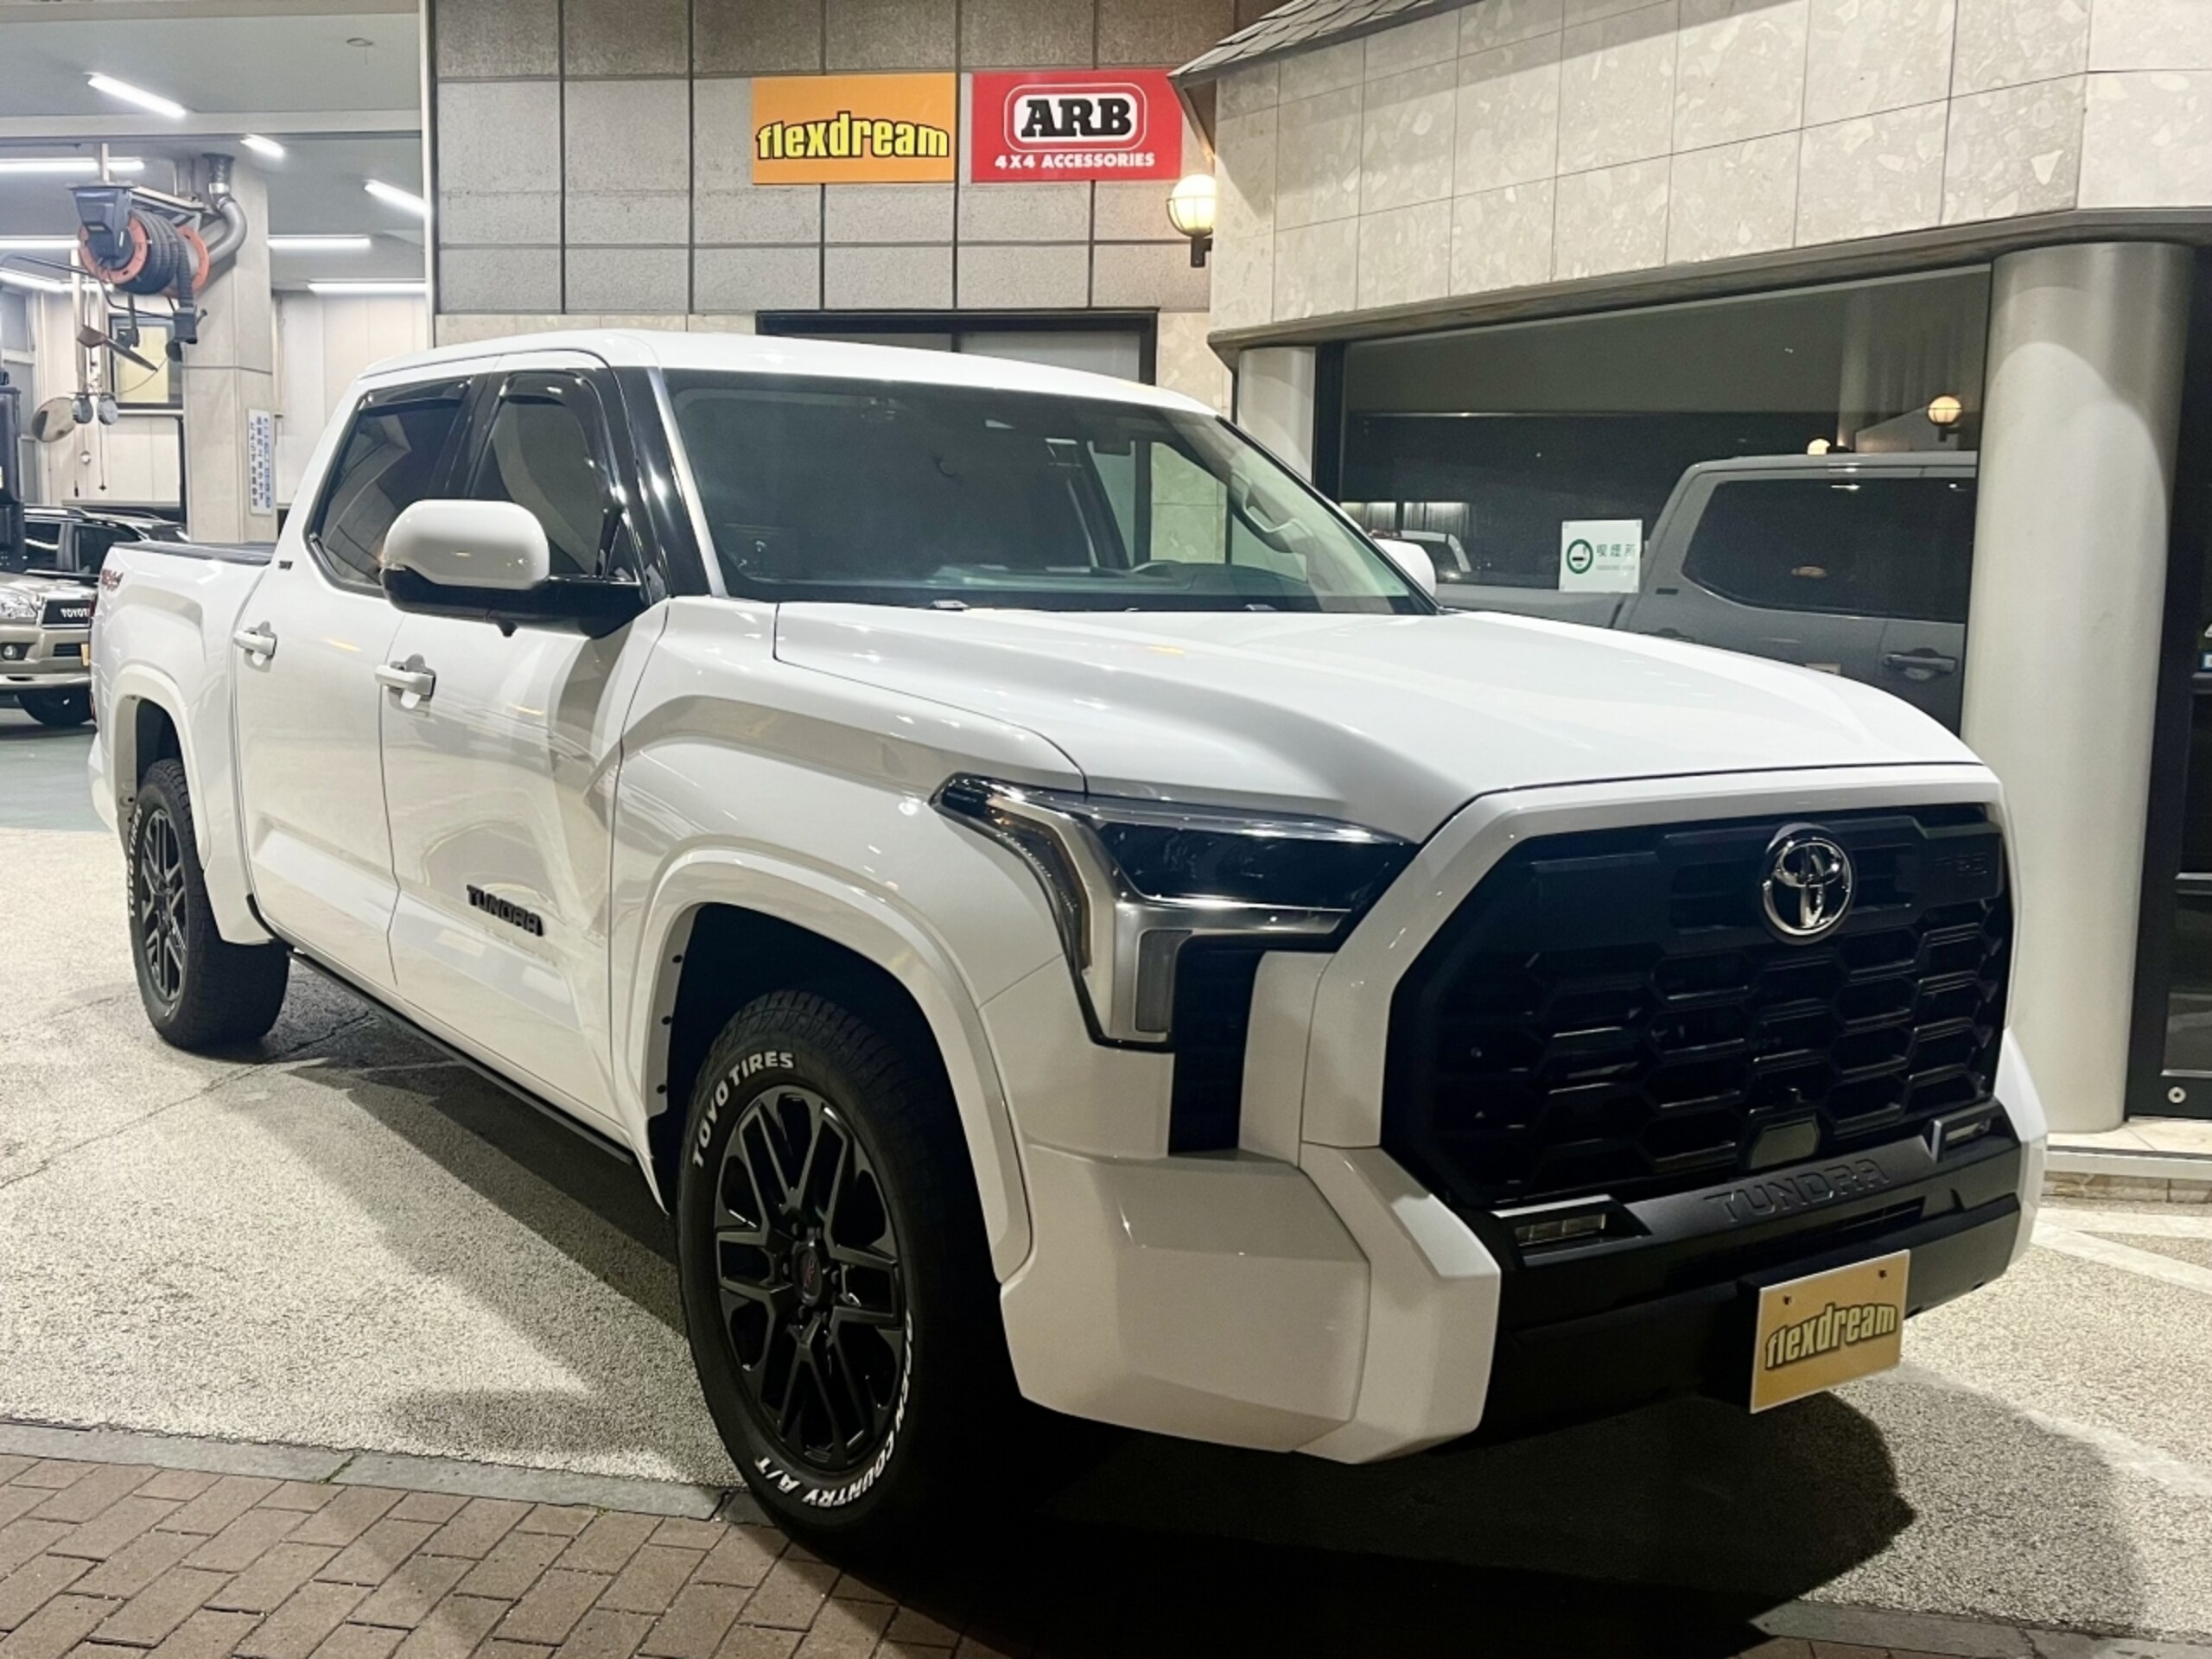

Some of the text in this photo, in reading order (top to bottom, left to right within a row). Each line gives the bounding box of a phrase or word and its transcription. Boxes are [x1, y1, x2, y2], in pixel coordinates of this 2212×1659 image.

[756, 111, 950, 160] flexdream
[1020, 98, 1132, 137] ARB
[995, 152, 1155, 169] 4X4 ACCESSORIES
[60, 607, 91, 619] TOYOT
[467, 884, 543, 937] TUNDRA
[692, 1051, 794, 1168] TOYO TIRES
[1702, 1158, 1891, 1224] TUNDRA
[1764, 1302, 1898, 1370] flexdream
[754, 1456, 802, 1494] A/T
[802, 1430, 895, 1508] COUNTRY
